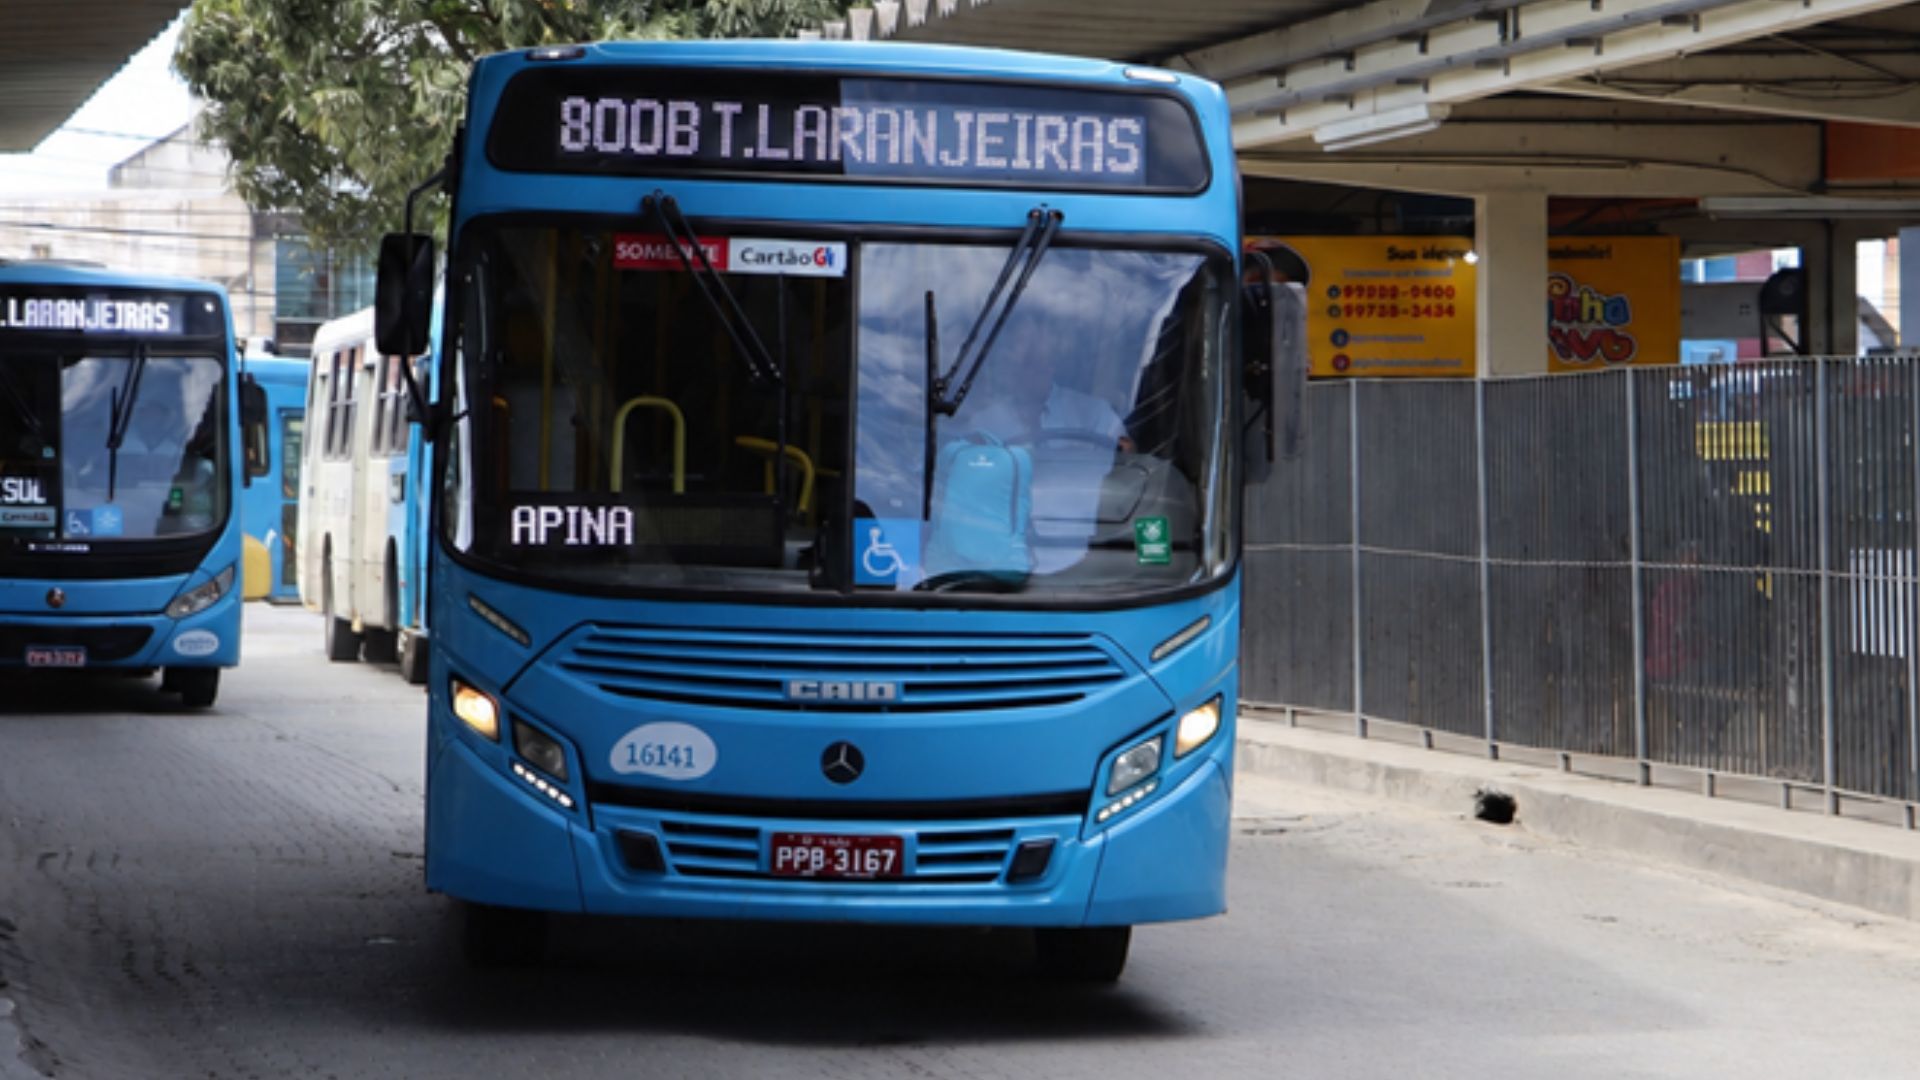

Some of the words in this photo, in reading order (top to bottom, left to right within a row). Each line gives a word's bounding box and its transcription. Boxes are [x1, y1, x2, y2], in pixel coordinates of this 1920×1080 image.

[560, 97, 700, 155] 800B
[712, 102, 1142, 175] T.LARANJEIRAS
[615, 242, 719, 263] SOMENE
[511, 505, 634, 545] APINA
[789, 681, 897, 700] CAIO
[625, 742, 696, 769] 16141
